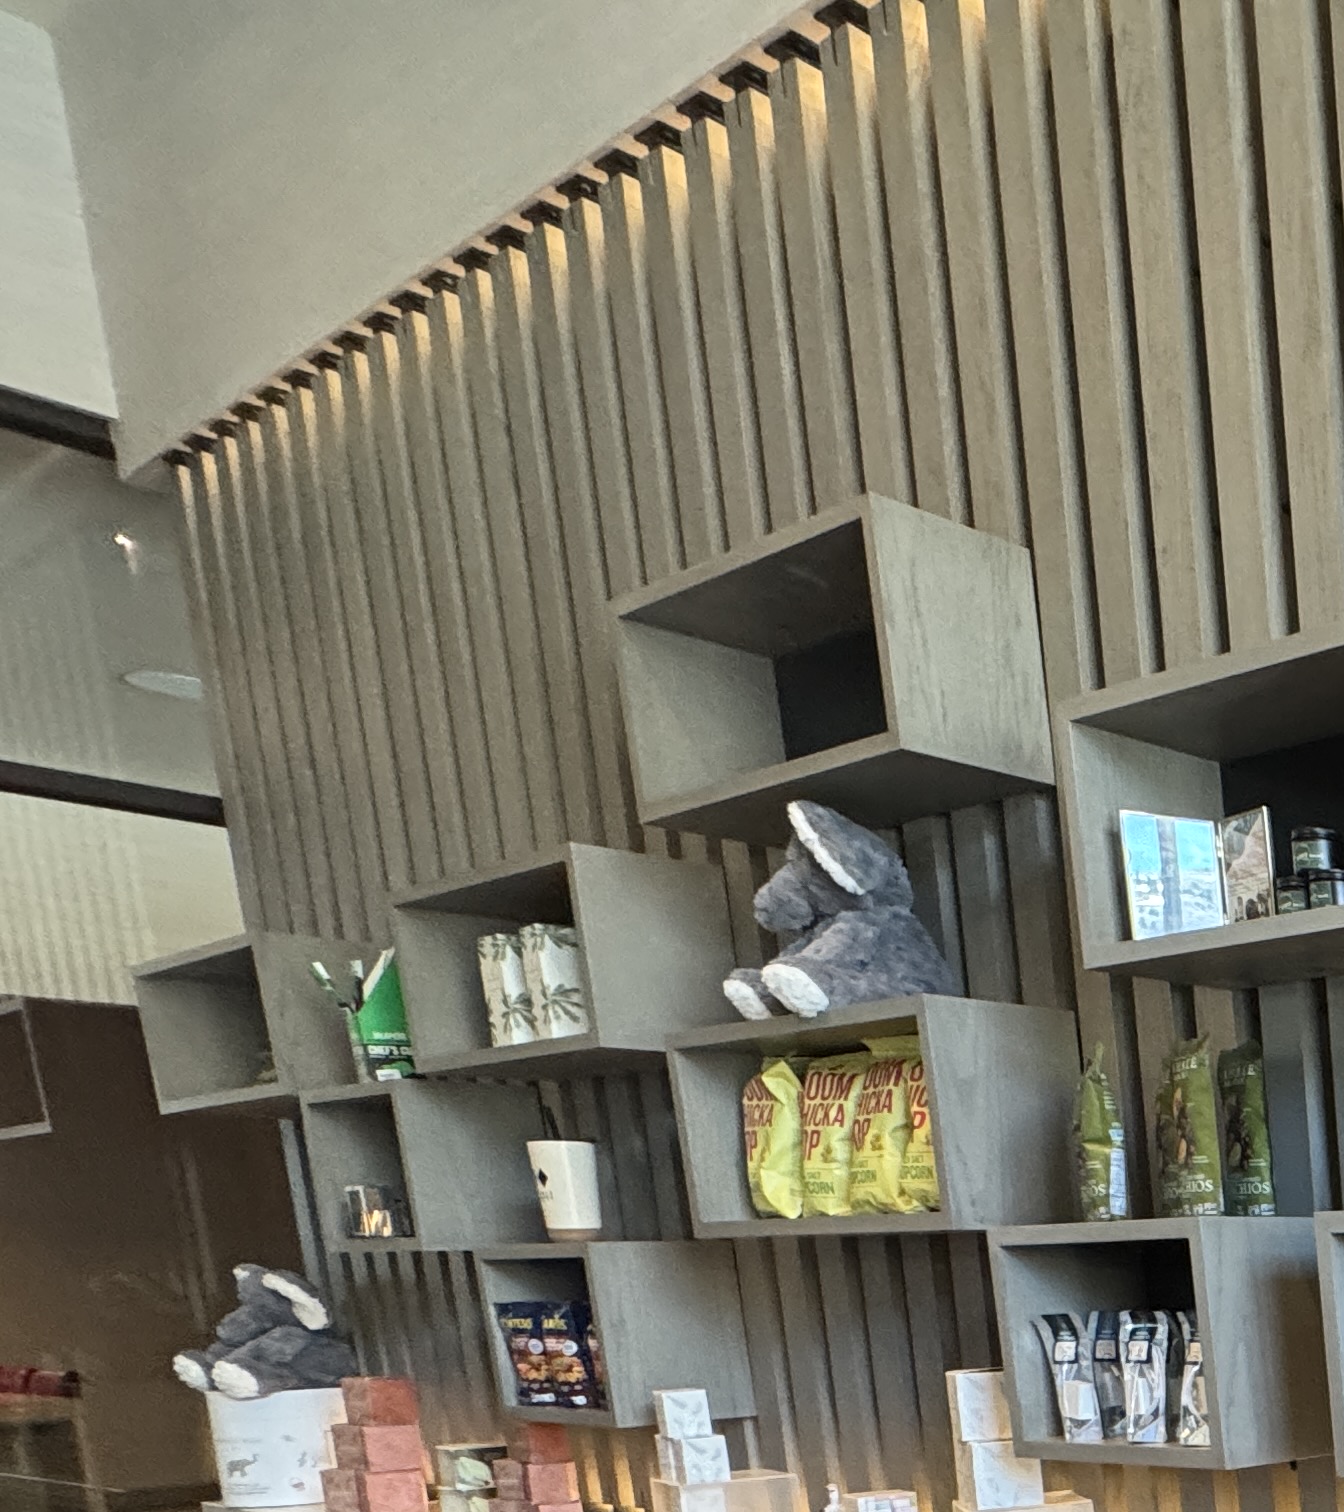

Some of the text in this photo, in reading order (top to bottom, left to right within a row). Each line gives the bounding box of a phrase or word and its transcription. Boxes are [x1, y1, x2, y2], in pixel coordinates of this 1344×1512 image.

[805, 1071, 857, 1101] OOM
[863, 1059, 906, 1091] OOM
[803, 1102, 845, 1129] HICKA
[857, 1089, 893, 1116] HICKA
[901, 1166, 933, 1181] OPCORN
